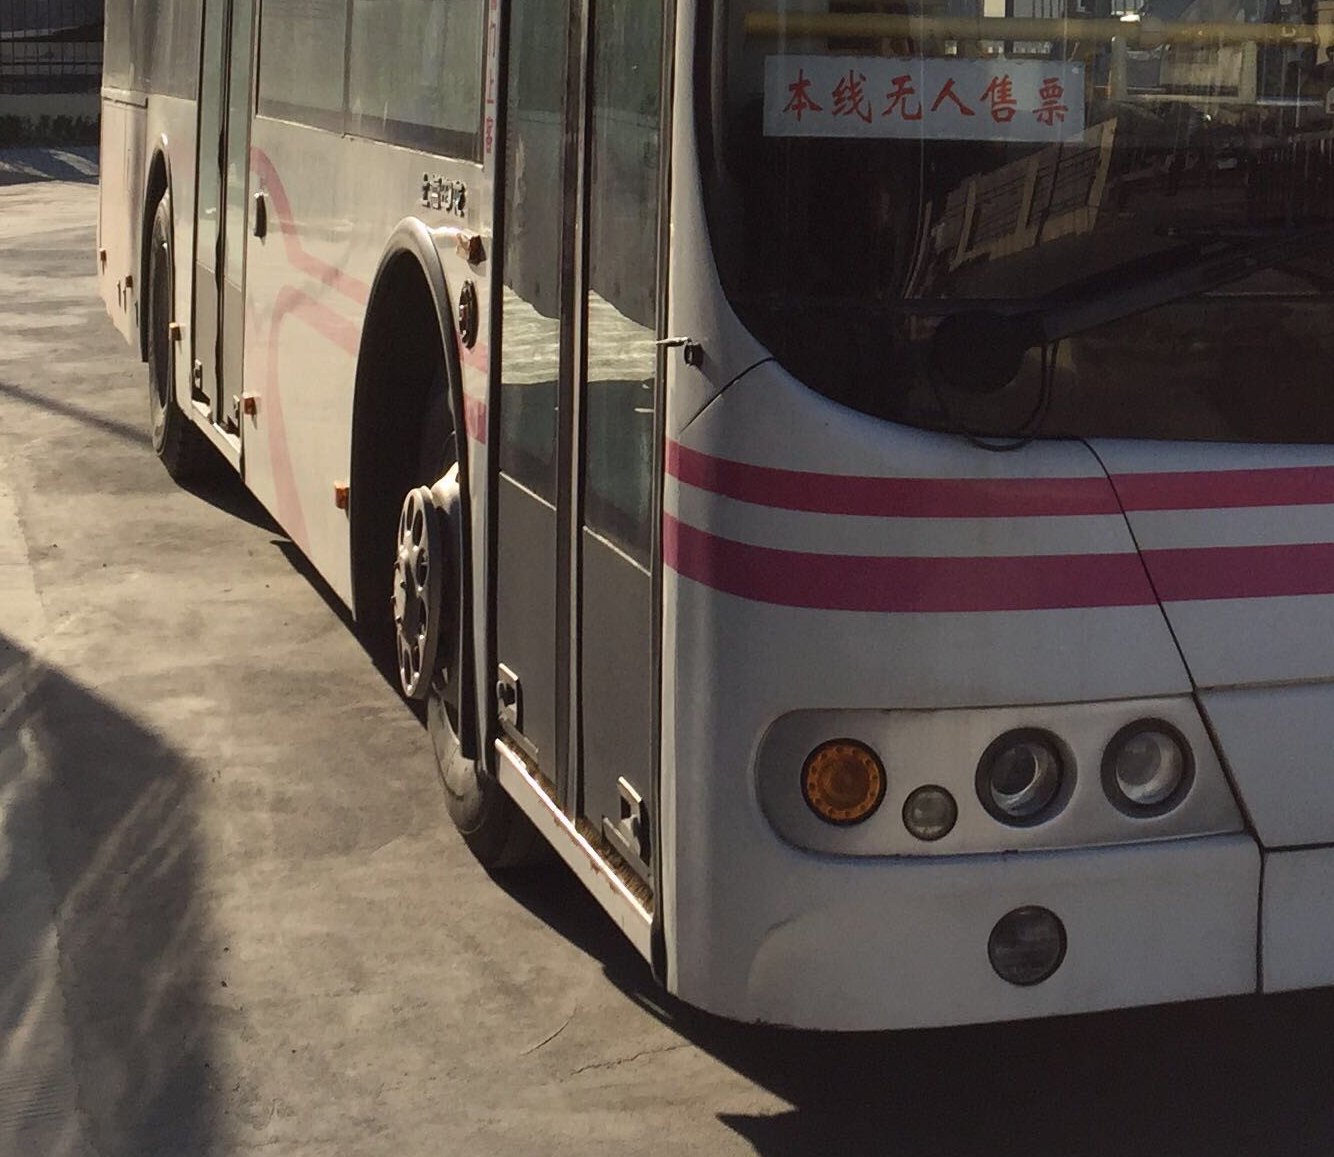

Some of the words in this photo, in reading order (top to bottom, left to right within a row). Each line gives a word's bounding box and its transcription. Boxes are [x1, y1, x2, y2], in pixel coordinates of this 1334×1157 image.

[782, 68, 1069, 127] 本线无人售票
